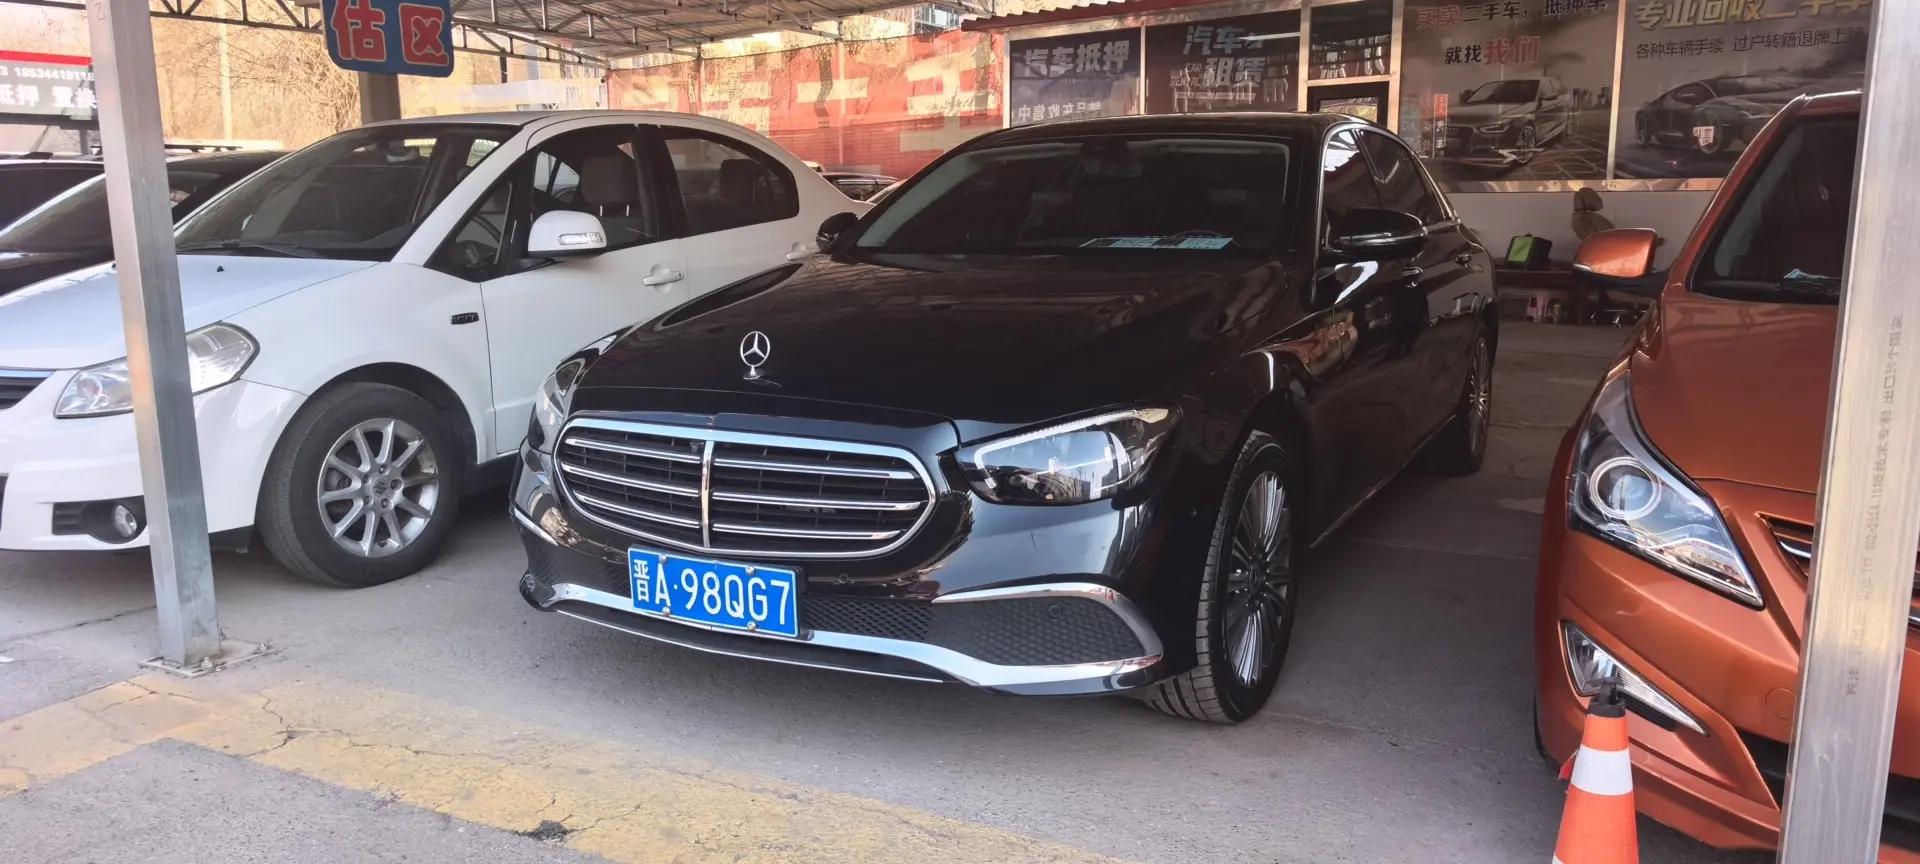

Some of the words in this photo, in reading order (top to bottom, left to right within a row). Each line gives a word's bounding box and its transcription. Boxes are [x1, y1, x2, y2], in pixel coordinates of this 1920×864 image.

[1183, 26, 1247, 55] 汽车
[1024, 40, 1129, 77] 汽车抵押
[1201, 57, 1266, 87] 租赁
[633, 558, 791, 626] 晋A·98QG7
